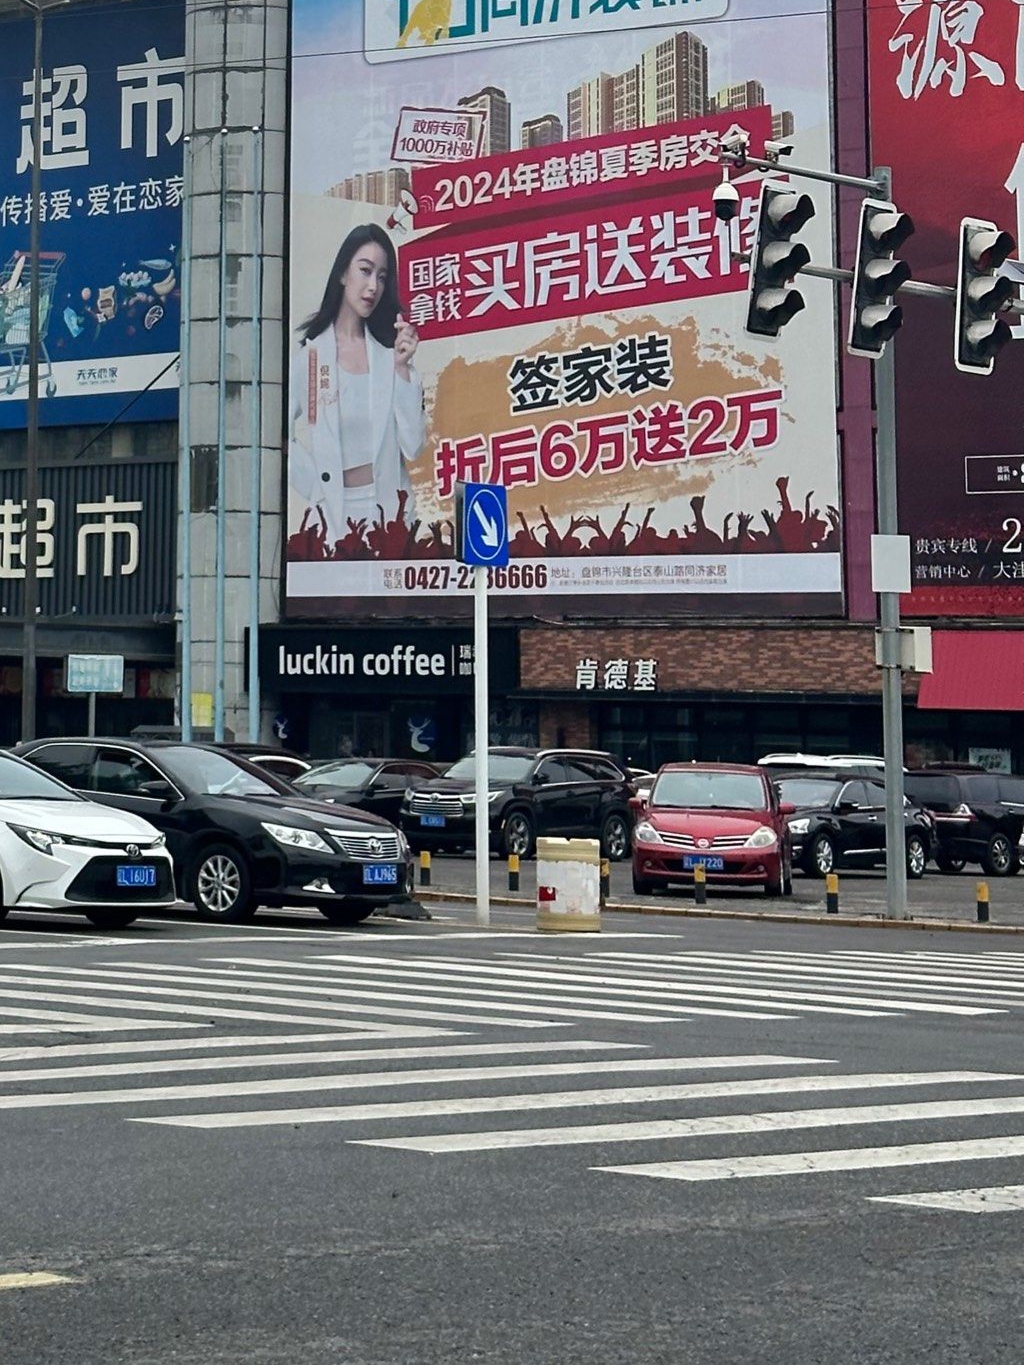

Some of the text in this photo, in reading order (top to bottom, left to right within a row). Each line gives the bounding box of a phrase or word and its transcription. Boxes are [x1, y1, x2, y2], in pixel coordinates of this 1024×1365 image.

[412, 119, 467, 138] 政府专项
[400, 137, 474, 157] 1000万补贴
[409, 252, 461, 291] 国家
[409, 288, 462, 327] 拿钱
[509, 334, 672, 415] 签家装
[435, 390, 783, 498] 折后6万送2万
[916, 537, 978, 554] 贵宾专线
[916, 564, 972, 579] 营销中心
[279, 645, 446, 676] luckin coffee
[576, 659, 657, 691] 肯德基
